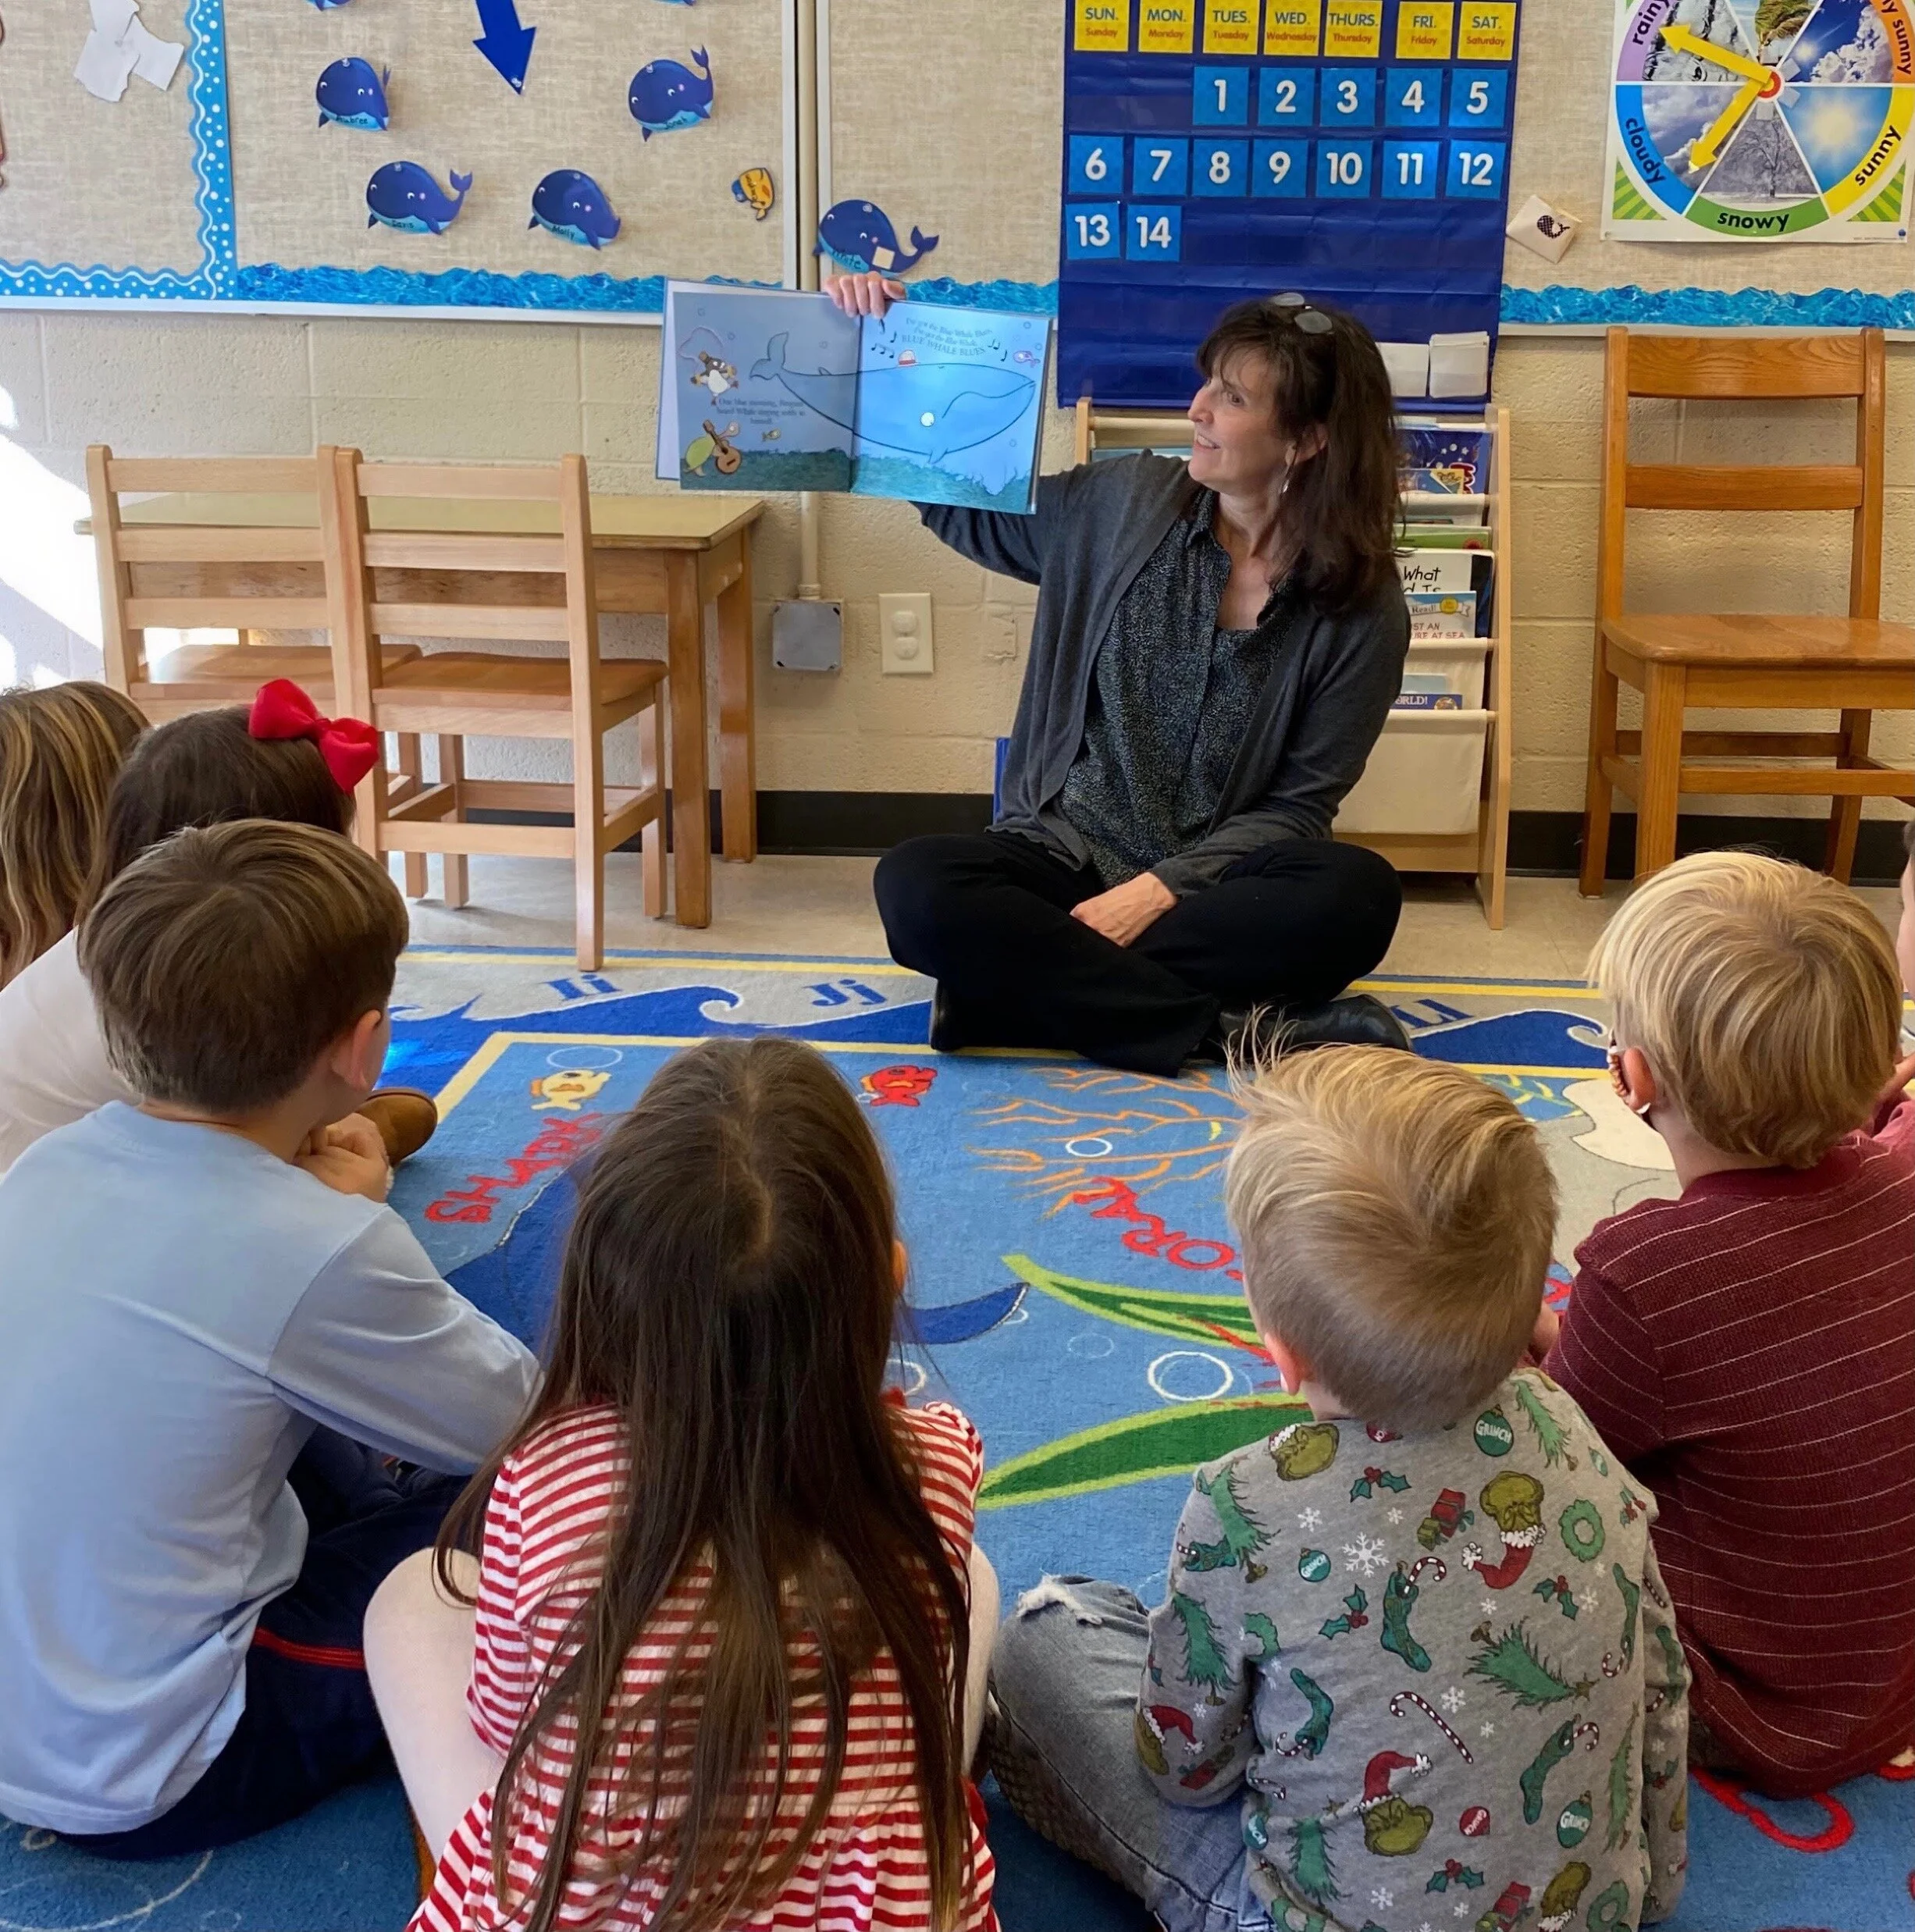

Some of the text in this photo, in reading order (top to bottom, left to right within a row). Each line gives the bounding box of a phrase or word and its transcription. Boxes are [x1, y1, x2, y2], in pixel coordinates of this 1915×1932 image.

[1085, 8, 1502, 29] SUN. MON. TUES. WED. THURS. FRI. SAT.
[1085, 28, 1506, 47] Sunday Monday Tuesday Wednesday Thursday Friday Saturday
[1892, 19, 1911, 75] sunny
[1214, 80, 1489, 114] 1 2 3 4 5
[1626, 117, 1666, 185] cloudy
[1855, 125, 1902, 187] sunny
[1085, 148, 1493, 186] 6 7 8 9 10 11 12
[1075, 215, 1172, 248] 13 14
[1717, 212, 1789, 232] snowy
[902, 334, 924, 344] BLUE
[927, 339, 957, 354] WHALE
[1404, 564, 1441, 582] What
[802, 978, 888, 1008] Jj
[1071, 1176, 1244, 1281] ORAL
[1475, 1419, 1513, 1444] GRINCH
[1300, 1553, 1328, 1578] GRINCH
